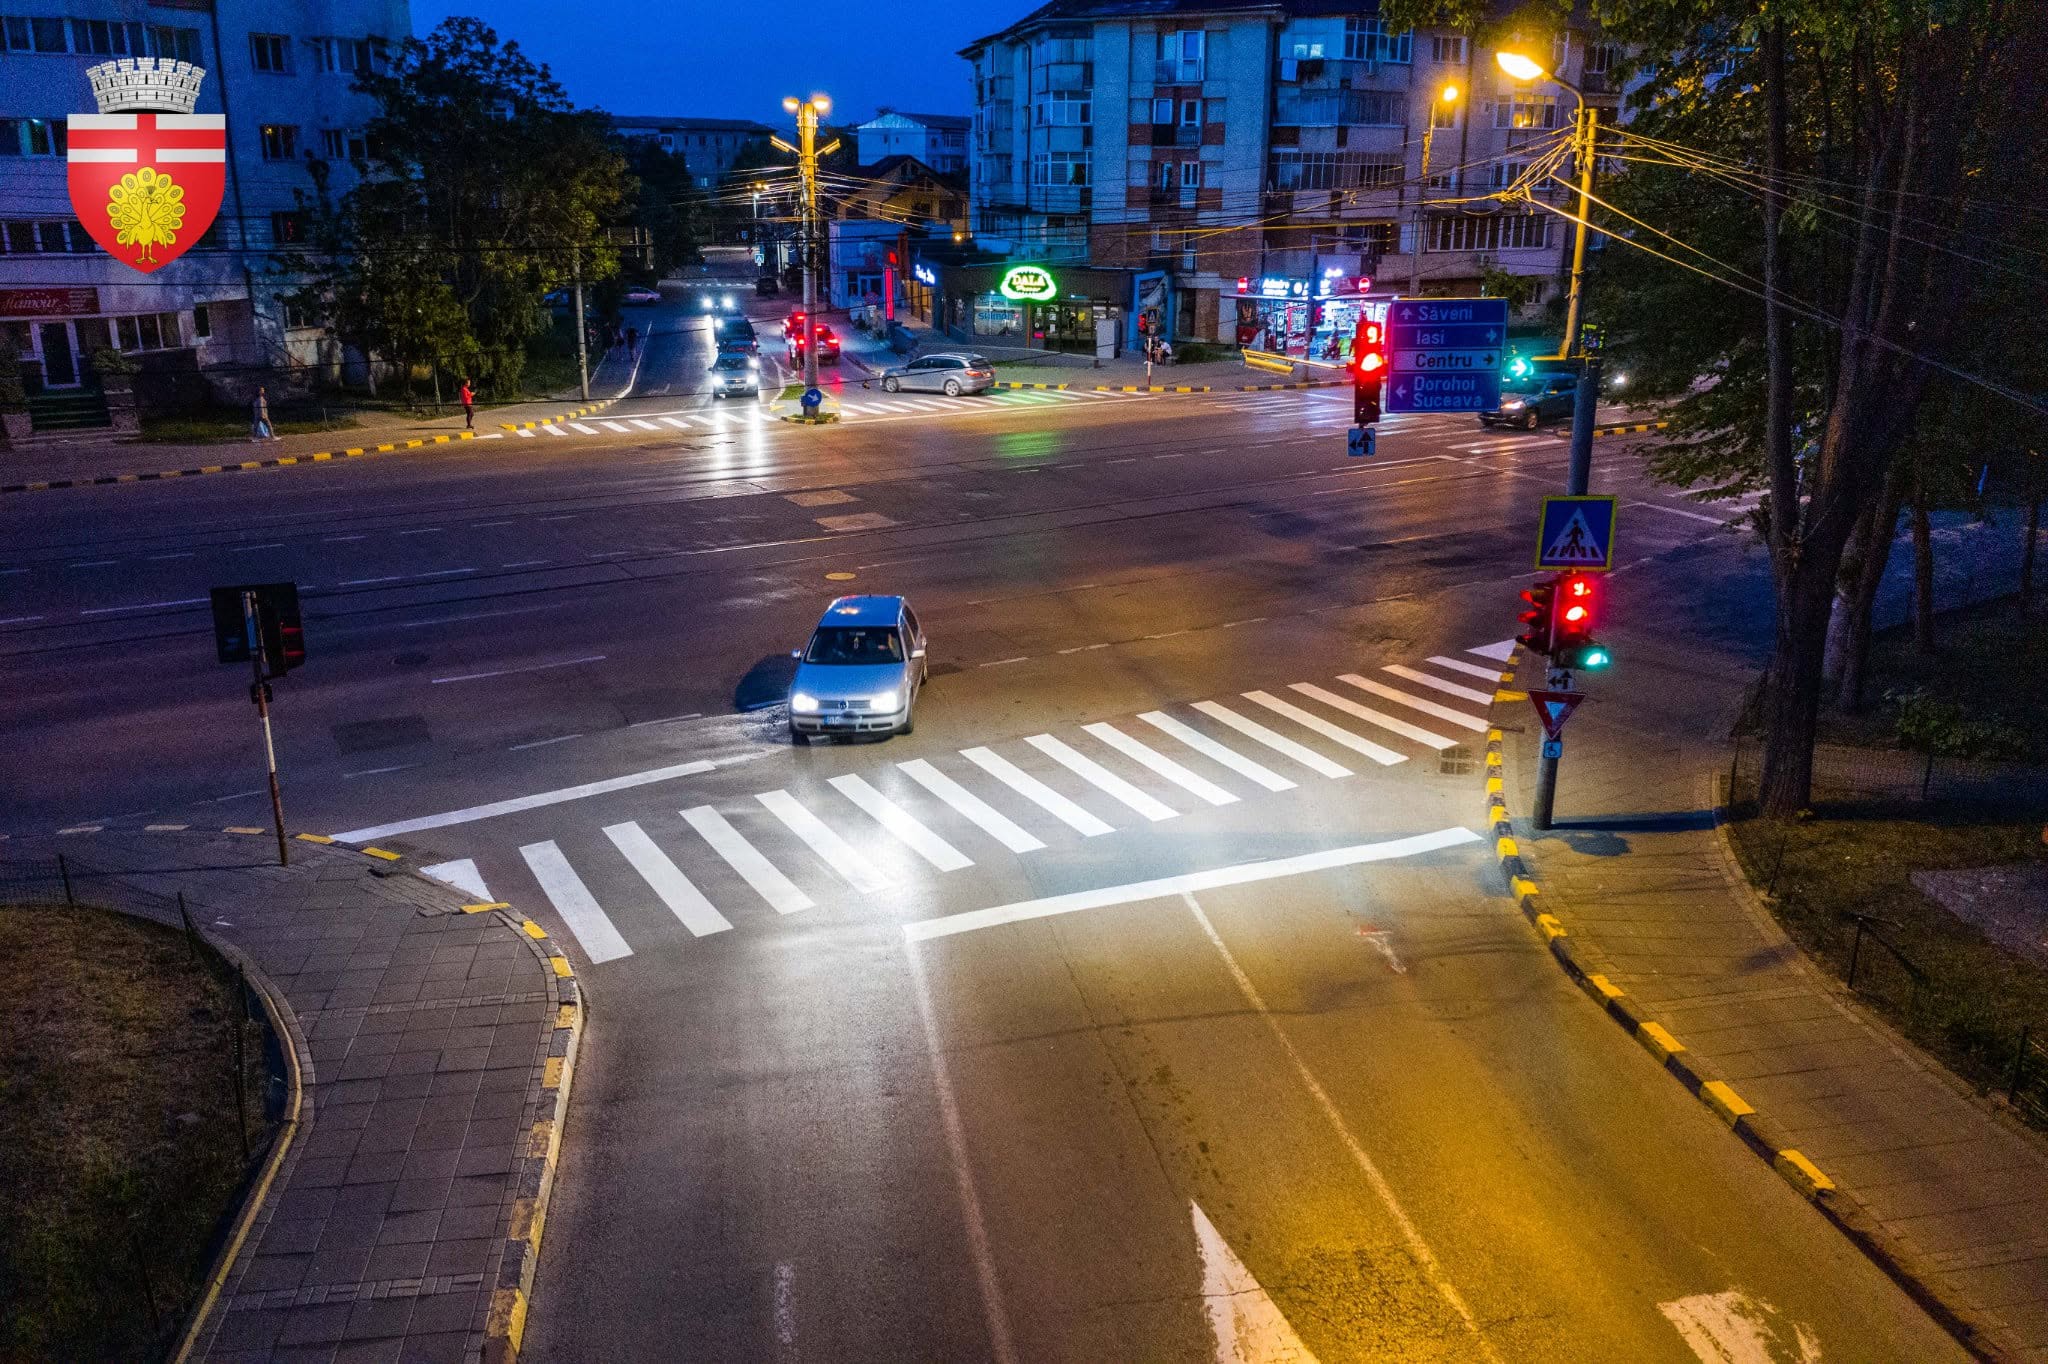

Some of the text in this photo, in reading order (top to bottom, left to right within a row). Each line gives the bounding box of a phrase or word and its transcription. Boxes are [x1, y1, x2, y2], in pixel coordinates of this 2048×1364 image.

[1012, 273, 1045, 286] DALA
[1415, 352, 1473, 368] Centru
[1413, 375, 1476, 391] Dorohoi
[1412, 392, 1482, 408] Suceava
